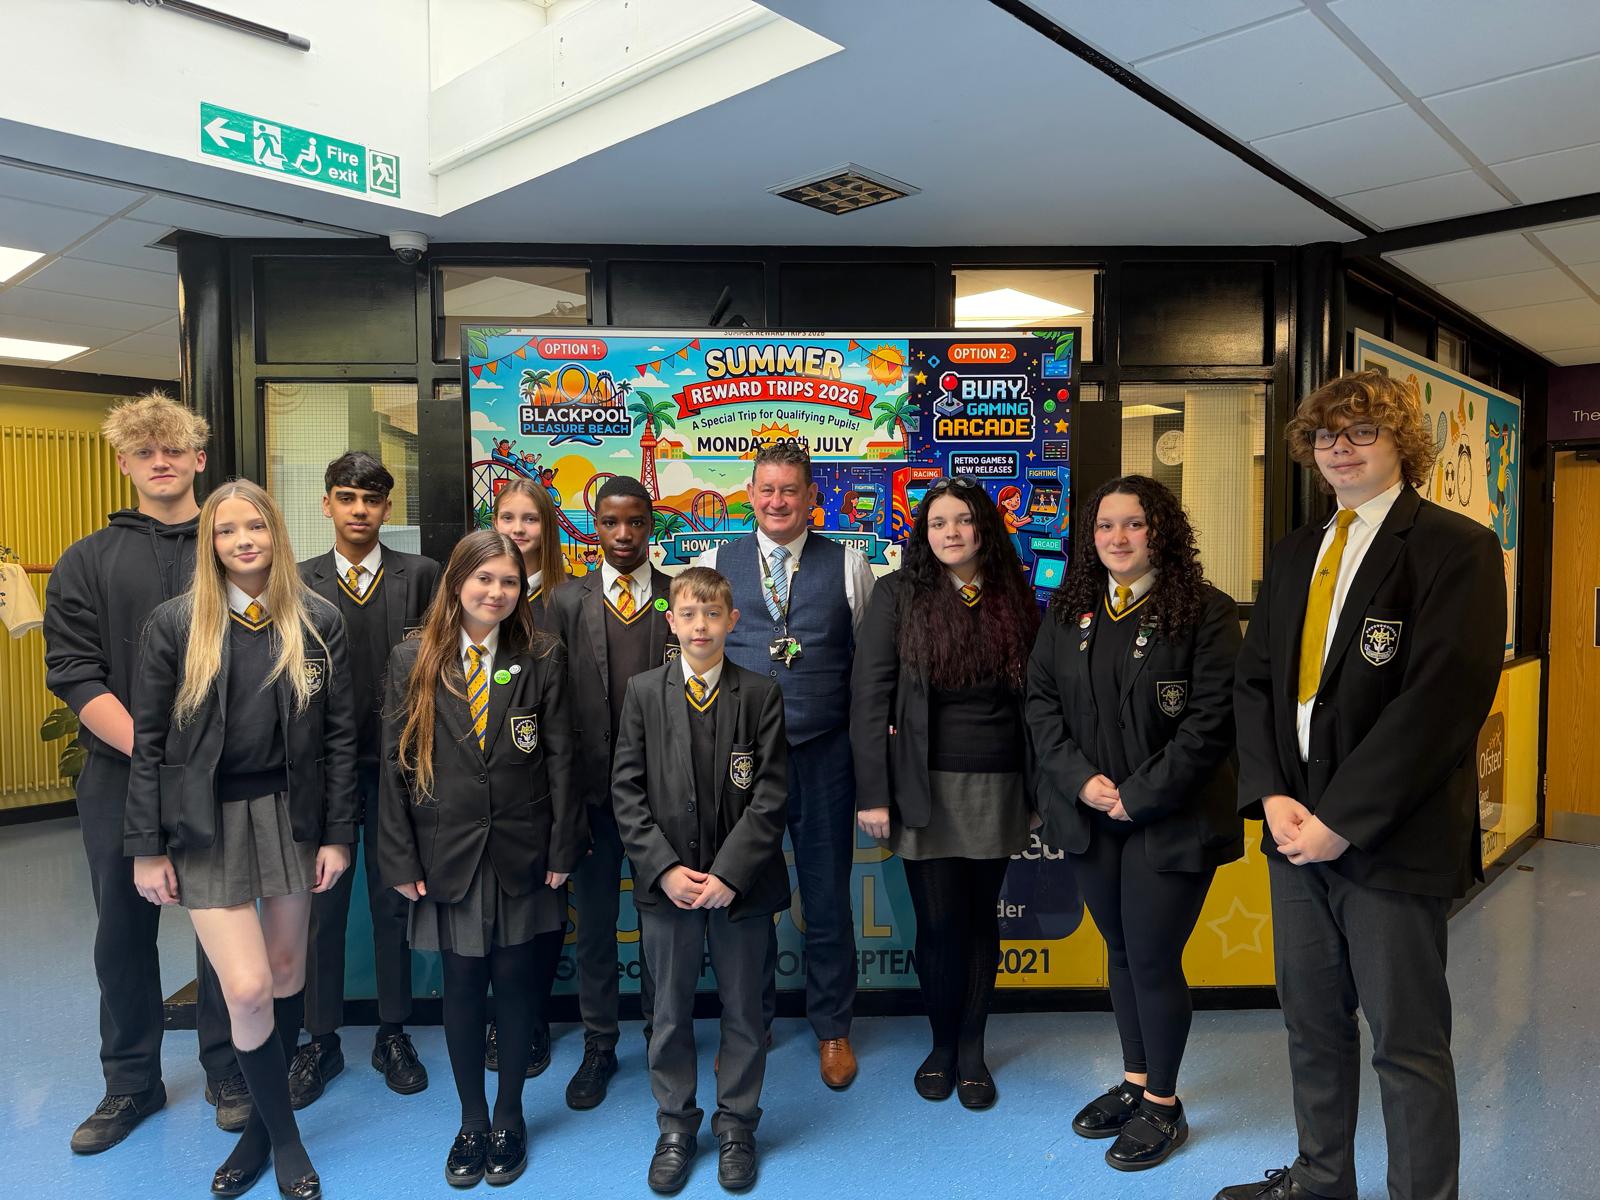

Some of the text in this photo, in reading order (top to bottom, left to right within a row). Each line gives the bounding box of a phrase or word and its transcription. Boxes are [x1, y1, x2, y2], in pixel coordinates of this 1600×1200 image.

[327, 145, 359, 166] Fire
[328, 166, 358, 184] exit
[544, 343, 600, 355] OPTION 1:
[953, 347, 1010, 359] OPTION 2:
[705, 345, 844, 379] SUMMER
[691, 380, 859, 405] REWARD TRIPS 2026
[961, 380, 1024, 399] BURY
[521, 408, 630, 423] BLACKPOOL
[966, 403, 1029, 416] GAMING
[1572, 409, 1600, 422] The
[692, 409, 860, 431] A Special Trip for Qualifying Pupils!
[522, 423, 630, 434] PLEASURE BEACH
[938, 418, 1031, 437] ARCADE
[813, 437, 853, 452] JULY
[954, 456, 1014, 465] RETRO GAMES &
[913, 470, 938, 478] RACING
[955, 465, 1012, 474] NEW RELEASES
[681, 539, 711, 551] HOW
[1033, 540, 1059, 549] ARCADE
[1479, 748, 1502, 779] Ofsted
